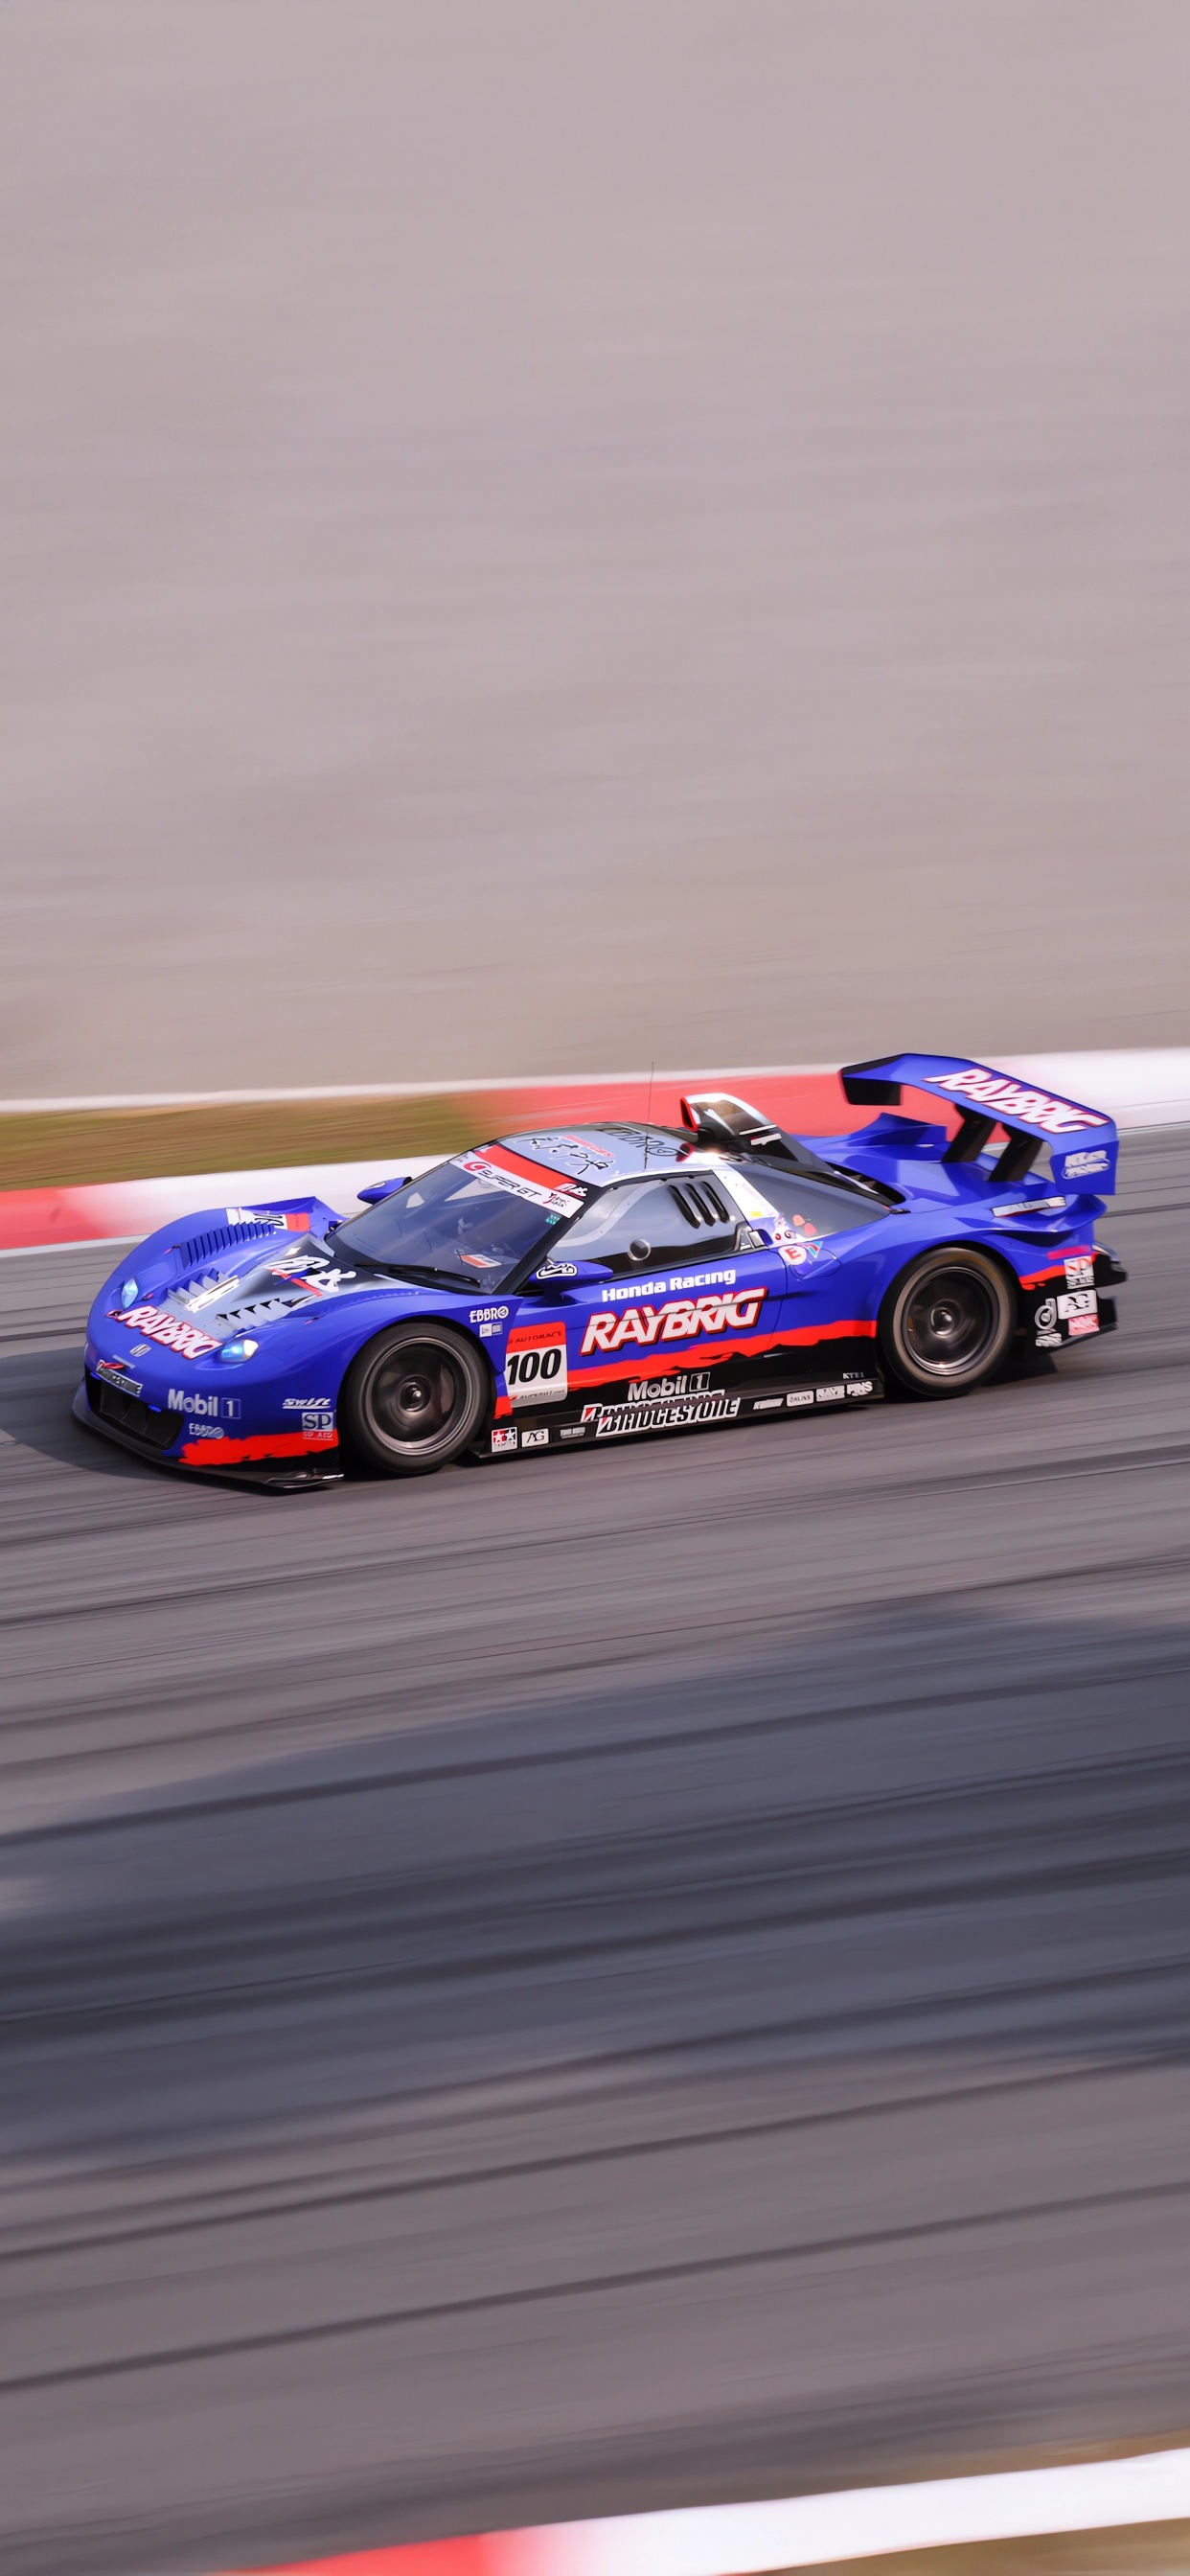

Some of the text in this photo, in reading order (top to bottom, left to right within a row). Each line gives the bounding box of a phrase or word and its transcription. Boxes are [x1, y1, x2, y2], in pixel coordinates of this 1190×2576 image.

[922, 1068, 1110, 1135] RAYBRIG
[602, 1269, 737, 1302] Honda Racing
[469, 1305, 510, 1323] EBBRO
[580, 1286, 767, 1355] RAYBRIG
[507, 1348, 561, 1386] 100
[628, 1375, 688, 1402] Mobil
[168, 1389, 218, 1417] Mobil
[303, 1414, 332, 1430] SP
[526, 1430, 545, 1443] AG
